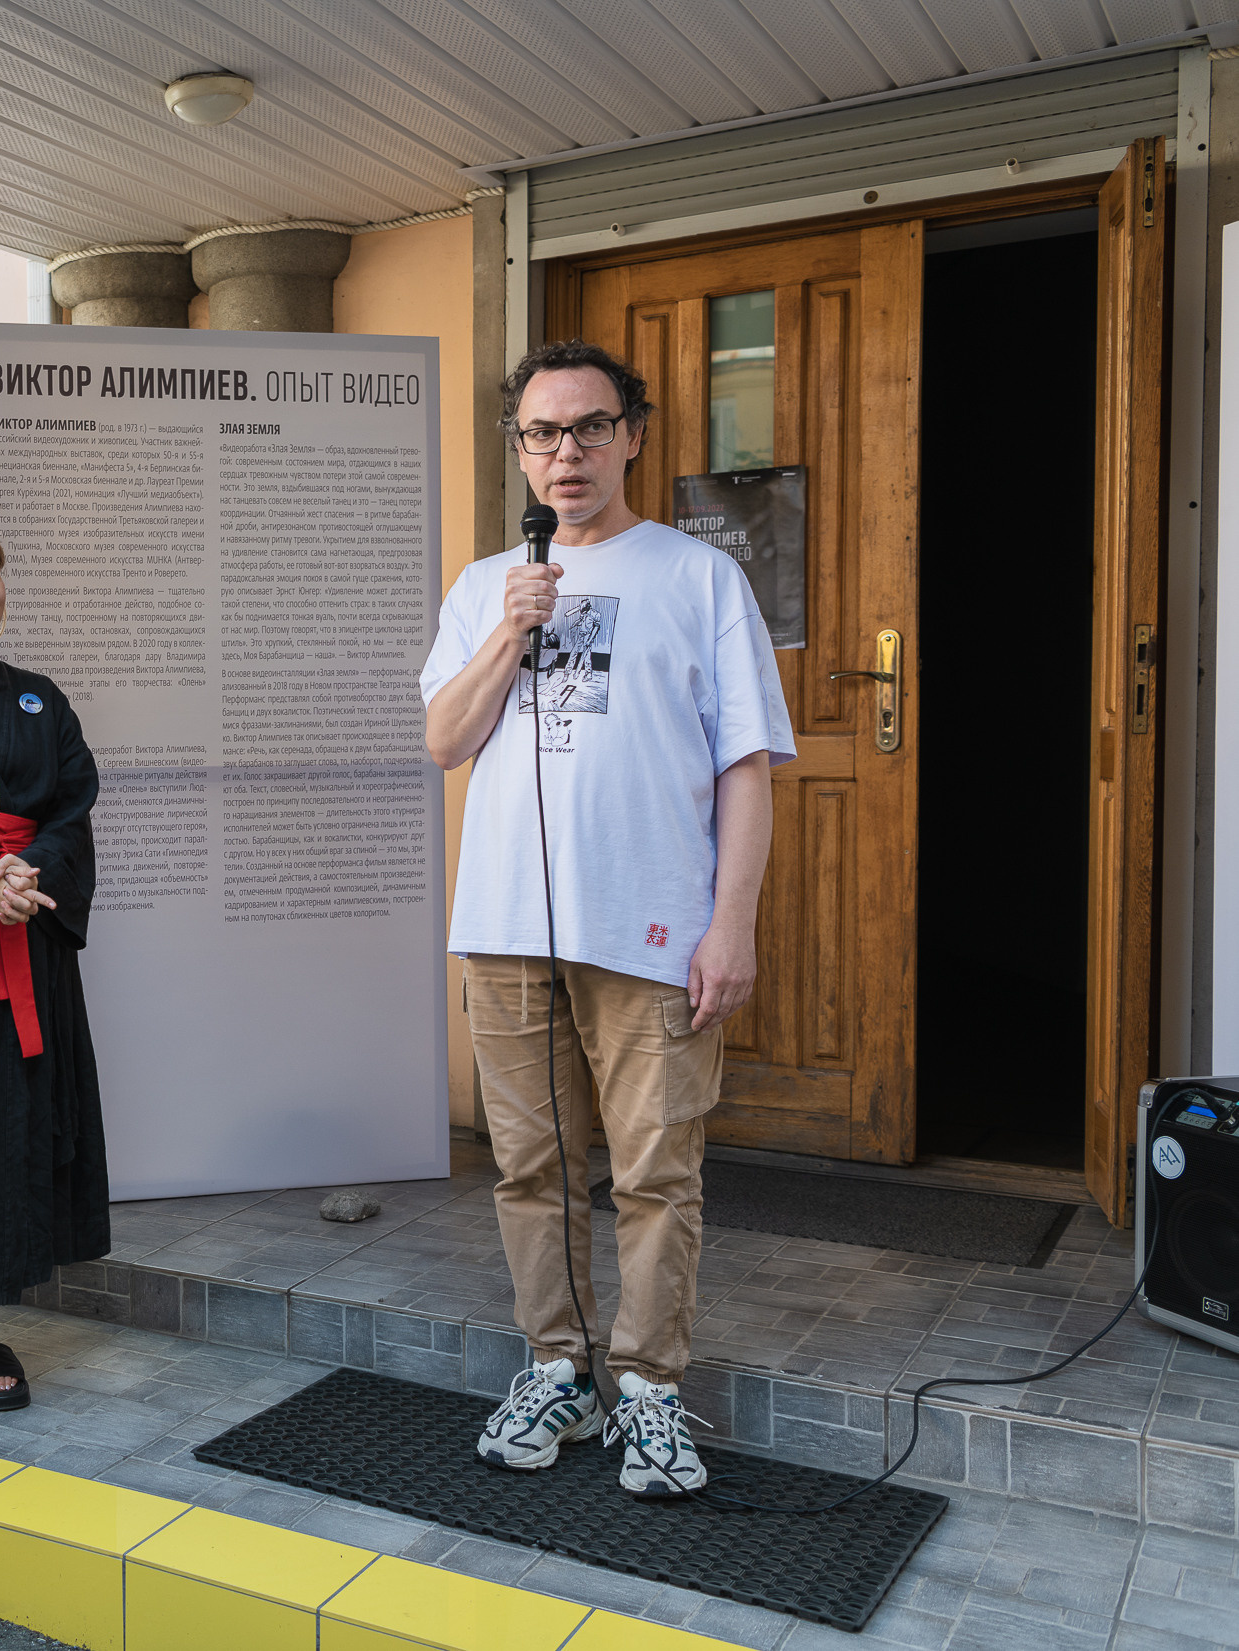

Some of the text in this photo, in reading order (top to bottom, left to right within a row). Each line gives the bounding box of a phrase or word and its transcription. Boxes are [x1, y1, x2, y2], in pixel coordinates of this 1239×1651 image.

[100, 366, 257, 402] АЛИМПИЕВ.
[266, 370, 333, 403] ОПЫТ
[343, 373, 419, 407] ВИДЕО
[36, 418, 96, 432] АЛИМПИЕВ
[98, 421, 115, 434] (род.
[124, 422, 138, 432] 1973
[139, 422, 147, 435] г.)
[158, 422, 203, 435] выдающийся
[220, 423, 280, 435] ЗЛАЯ ЗЕМЛЯ
[33, 436, 89, 447] видеохудожник
[98, 437, 138, 447] живописец.
[140, 436, 172, 446] Участник
[174, 436, 203, 446] важней-
[8, 448, 69, 460] международных
[70, 450, 105, 460] выставок,
[107, 450, 129, 461] среди
[132, 450, 160, 461] которых
[163, 449, 178, 459] 50-я
[189, 449, 204, 460] 55-я
[42, 460, 79, 472] биеннале,
[80, 461, 124, 474] «Манифеста
[126, 462, 136, 473] 5»,
[137, 462, 148, 472] 4-я
[150, 462, 190, 475] Берлинская
[191, 463, 204, 473] би-
[219, 455, 232, 465] гой:
[235, 458, 283, 468] современным
[285, 458, 324, 466] состоянием
[327, 459, 346, 469] мира,
[348, 460, 391, 469] отдающимся
[400, 460, 421, 468] наших
[20, 473, 30, 483] 2-я
[38, 474, 50, 483] 5-я
[50, 474, 92, 484] Московская
[93, 474, 127, 485] биеннале
[134, 477, 145, 487] др.
[146, 475, 174, 488] Лауреат
[176, 476, 204, 488] Премии
[220, 470, 421, 483] сердцах тревожным чувством потери этой самой современ-
[17, 487, 50, 499] Курёхина
[52, 487, 72, 500] (2021,
[74, 490, 115, 499] номинация
[117, 488, 148, 500] «Лучший
[150, 489, 203, 501] медиаобъект»).
[244, 482, 256, 491] Это
[257, 484, 280, 493] земля,
[281, 482, 330, 494] вздыбившаяся
[331, 485, 344, 494] под
[346, 485, 372, 494] ногами,
[374, 485, 422, 496] вынуждающая
[22, 500, 54, 512] работает
[62, 500, 90, 511] Москве.
[91, 500, 142, 514] Произведения
[144, 501, 184, 512] Алимпиева
[184, 504, 204, 512] нахо-
[18, 514, 56, 526] собраниях
[57, 514, 117, 526] Государственной
[119, 515, 169, 527] Третьяковской
[170, 517, 198, 527] галереи
[677, 516, 725, 532] ВИКТОР
[691, 531, 751, 546] МПИЕВ.
[221, 613, 232, 621] как
[234, 611, 244, 621] бы
[245, 613, 290, 622] поднимается
[291, 613, 314, 621] тонкая
[315, 613, 336, 623] вуаль,
[358, 613, 380, 622] всегда
[382, 613, 423, 623] скрывающая
[221, 626, 228, 634] от
[230, 626, 242, 634] нас
[243, 626, 259, 636] мир.
[261, 624, 290, 636] Поэтому
[291, 626, 318, 636] говорят,
[338, 626, 373, 636] эпицентре
[374, 626, 402, 635] циклона
[403, 626, 422, 635] царит
[14, 640, 24, 648] же
[24, 640, 71, 650] выверенным
[72, 640, 106, 650] звуковым
[107, 640, 132, 650] рядом.
[139, 637, 156, 647] 2020
[157, 639, 172, 650] году
[178, 639, 205, 647] коллек-
[109, 772, 143, 782] странные
[144, 771, 174, 782] ритуалы
[174, 768, 207, 780] действия
[99, 860, 208, 874] ритмика движений, повторяе-
[224, 882, 426, 898] ем, отмеченным продуманной композицией, динамичным
[224, 900, 278, 911] кадрированием
[286, 898, 331, 909] характерным
[333, 896, 390, 907] «алимпиевским»,
[392, 895, 426, 905] построен-
[224, 909, 390, 924] ным на полутонах сближенных цветов колоритом.
